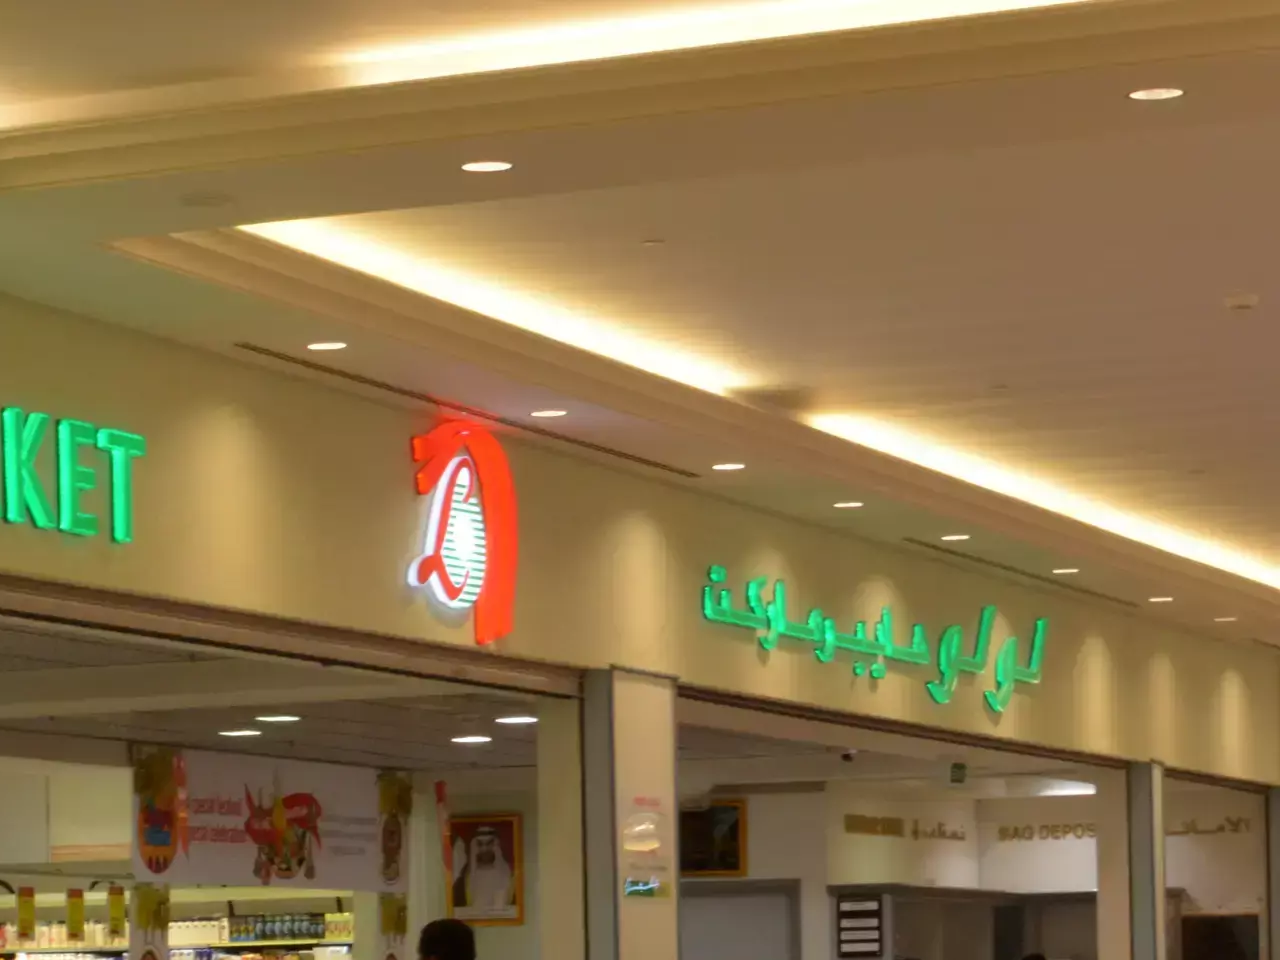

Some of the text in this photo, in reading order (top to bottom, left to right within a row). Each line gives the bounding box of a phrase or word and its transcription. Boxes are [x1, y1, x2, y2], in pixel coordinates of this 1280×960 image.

[701, 564, 1049, 714] لولو هايبرماركت
[1038, 822, 1098, 840] DEPOS
